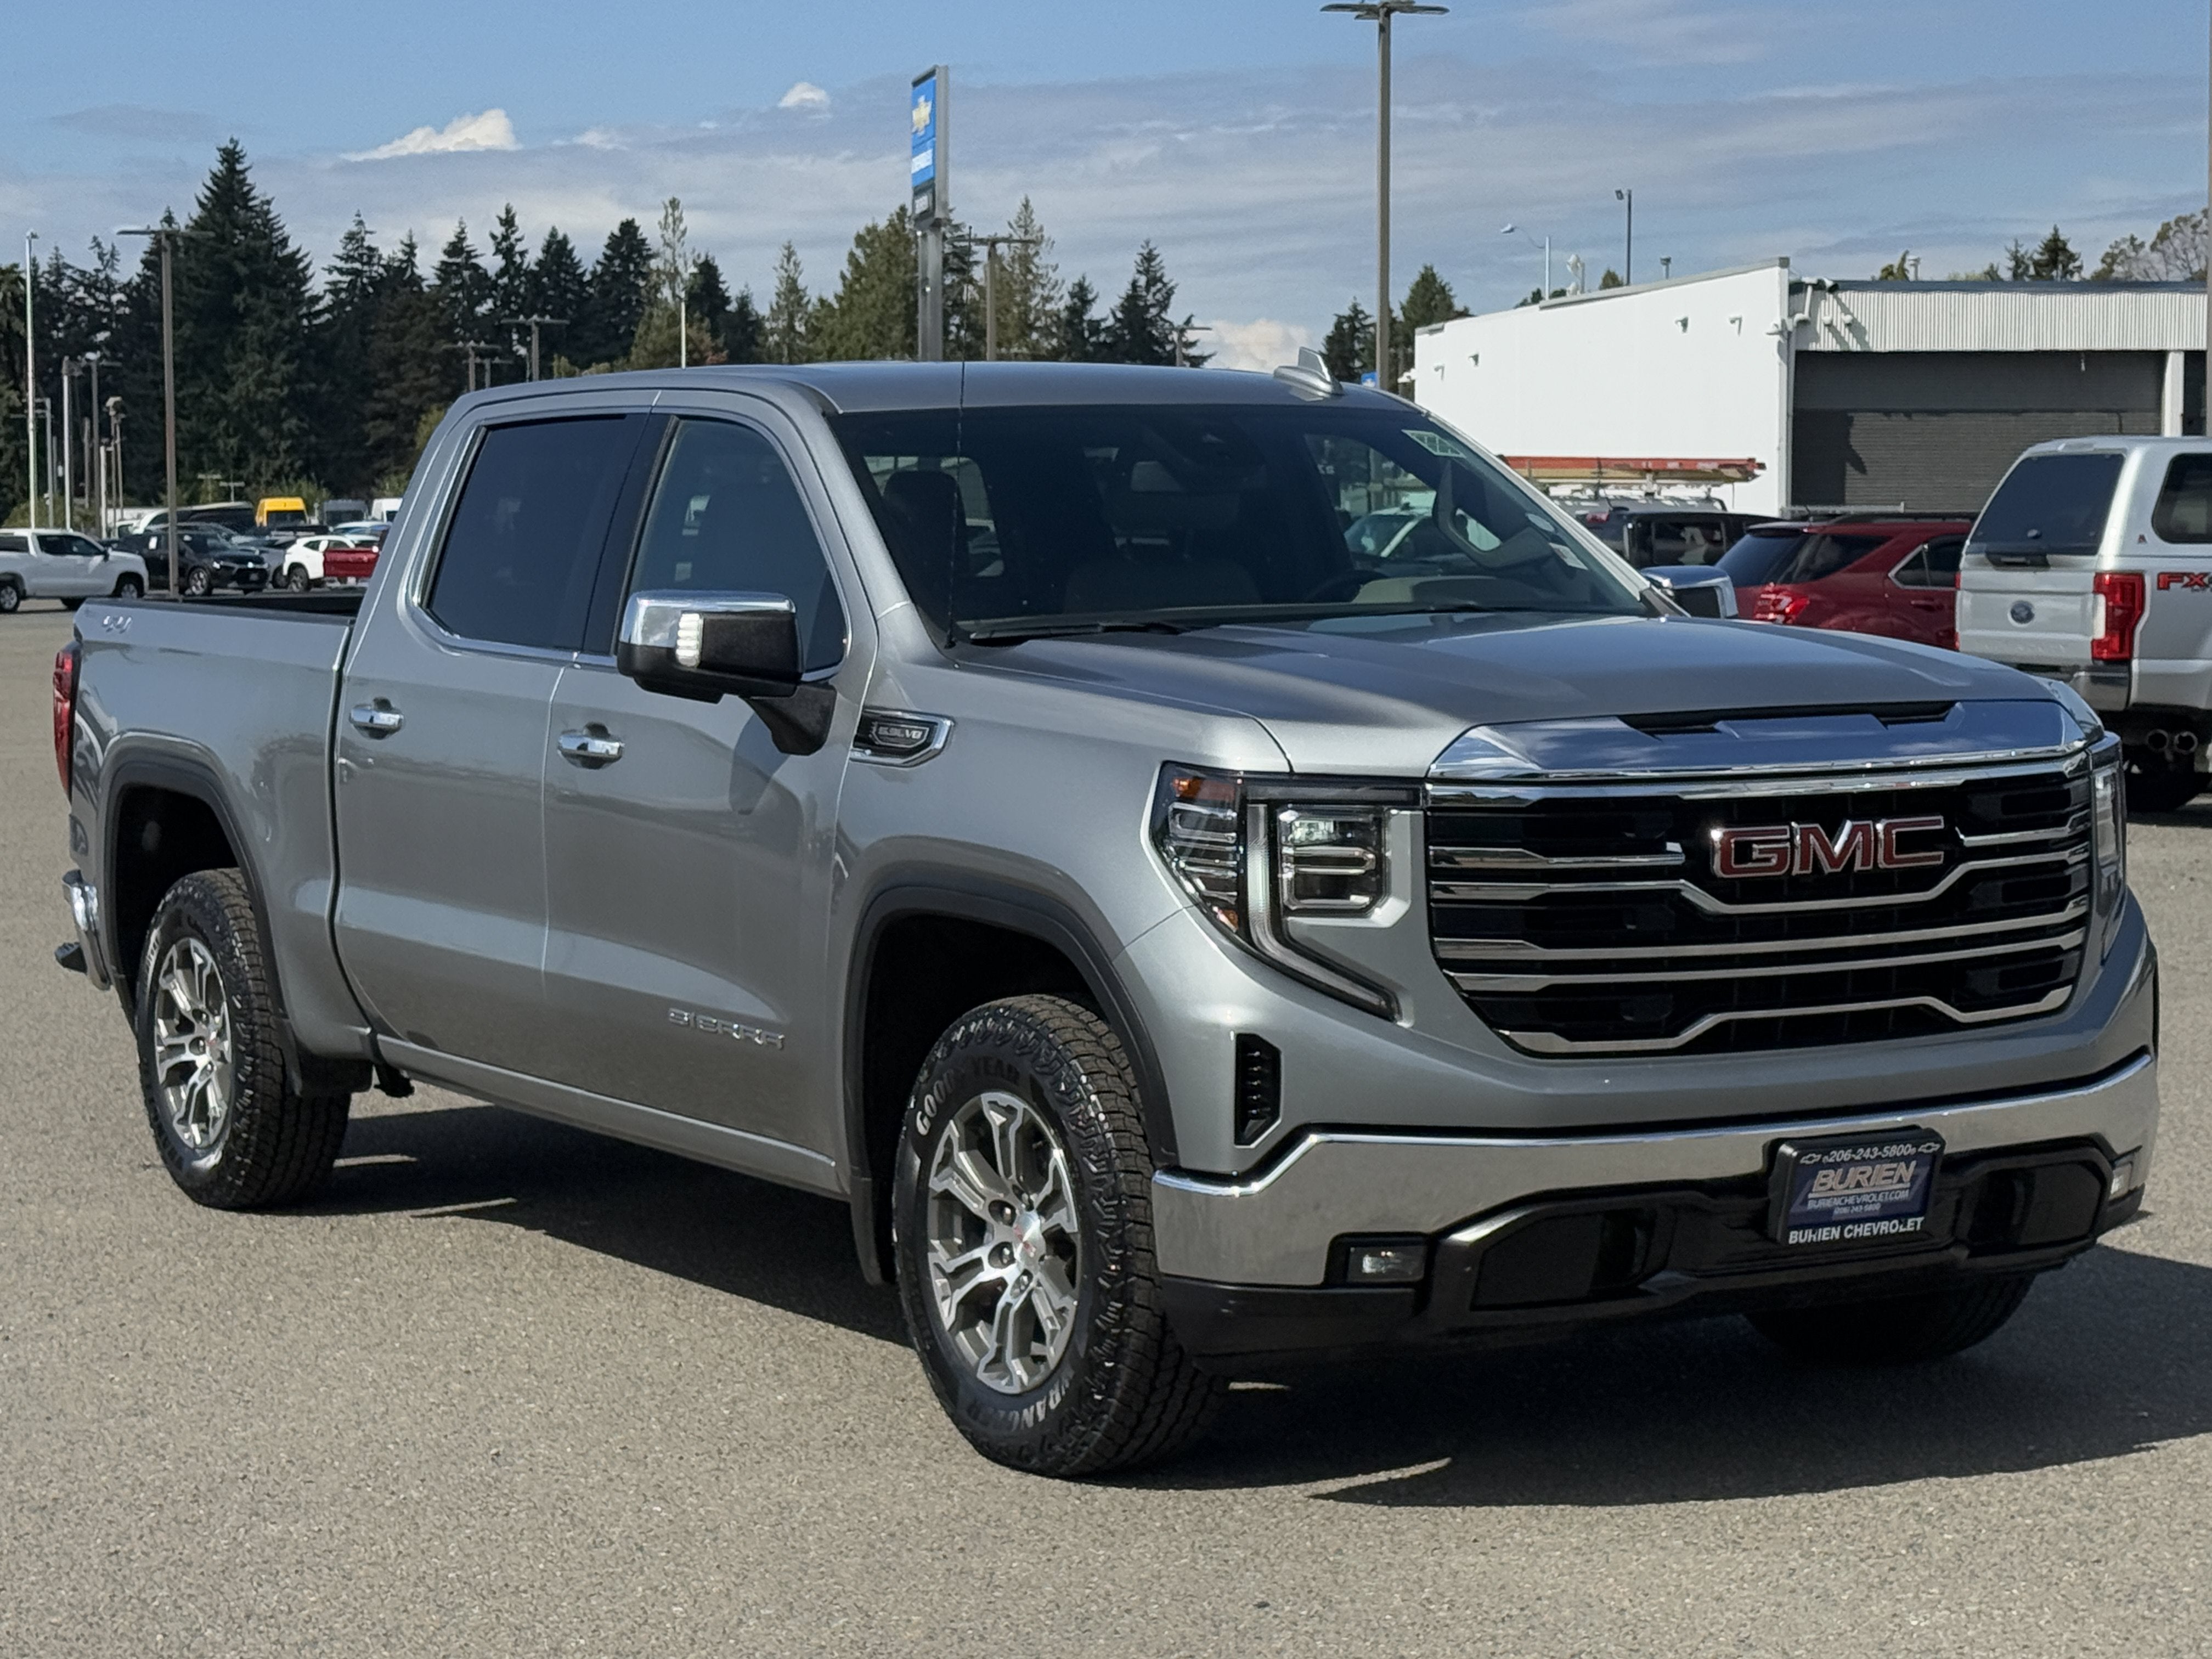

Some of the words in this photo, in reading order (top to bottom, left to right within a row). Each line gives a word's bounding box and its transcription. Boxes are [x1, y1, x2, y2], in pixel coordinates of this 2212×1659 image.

[2157, 572, 2212, 591] FX
[1710, 815, 1945, 878] GMC
[1829, 1144, 1912, 1163] 206-243-5800
[1812, 1160, 1917, 1193] BURIEN
[1788, 1225, 1840, 1245] BURIEN
[1843, 1216, 1925, 1239] CHEVROLET
